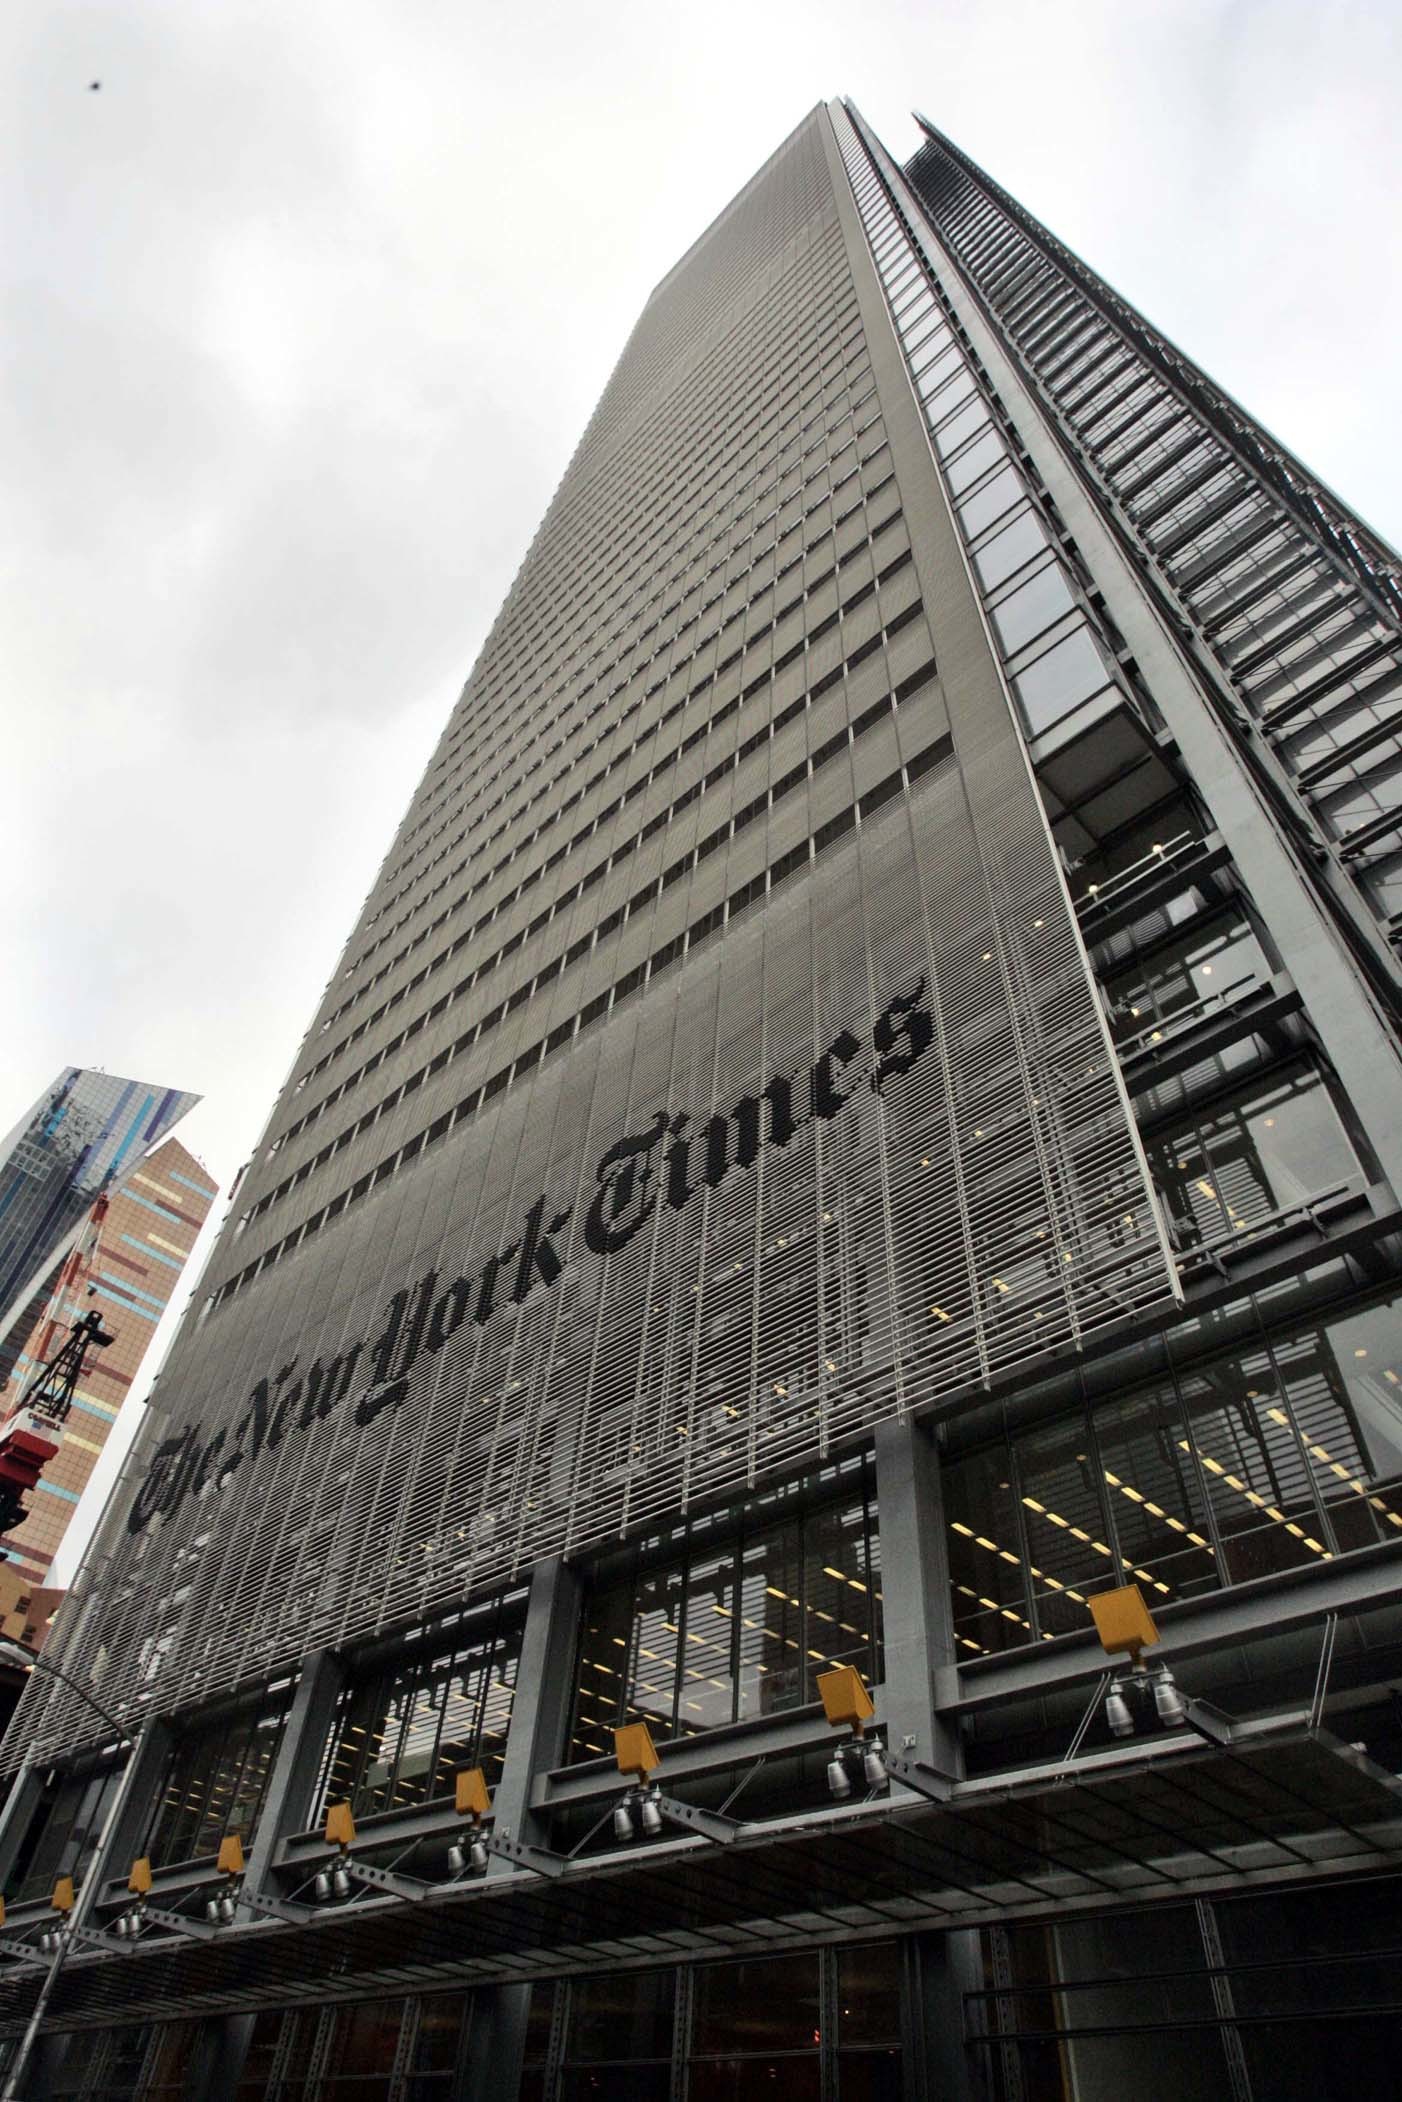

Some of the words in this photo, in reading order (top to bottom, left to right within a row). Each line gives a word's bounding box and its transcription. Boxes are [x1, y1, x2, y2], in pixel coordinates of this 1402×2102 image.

[127, 1420, 227, 1535] The
[214, 1339, 367, 1491] New
[354, 1193, 573, 1426] York
[584, 976, 934, 1254] Times
